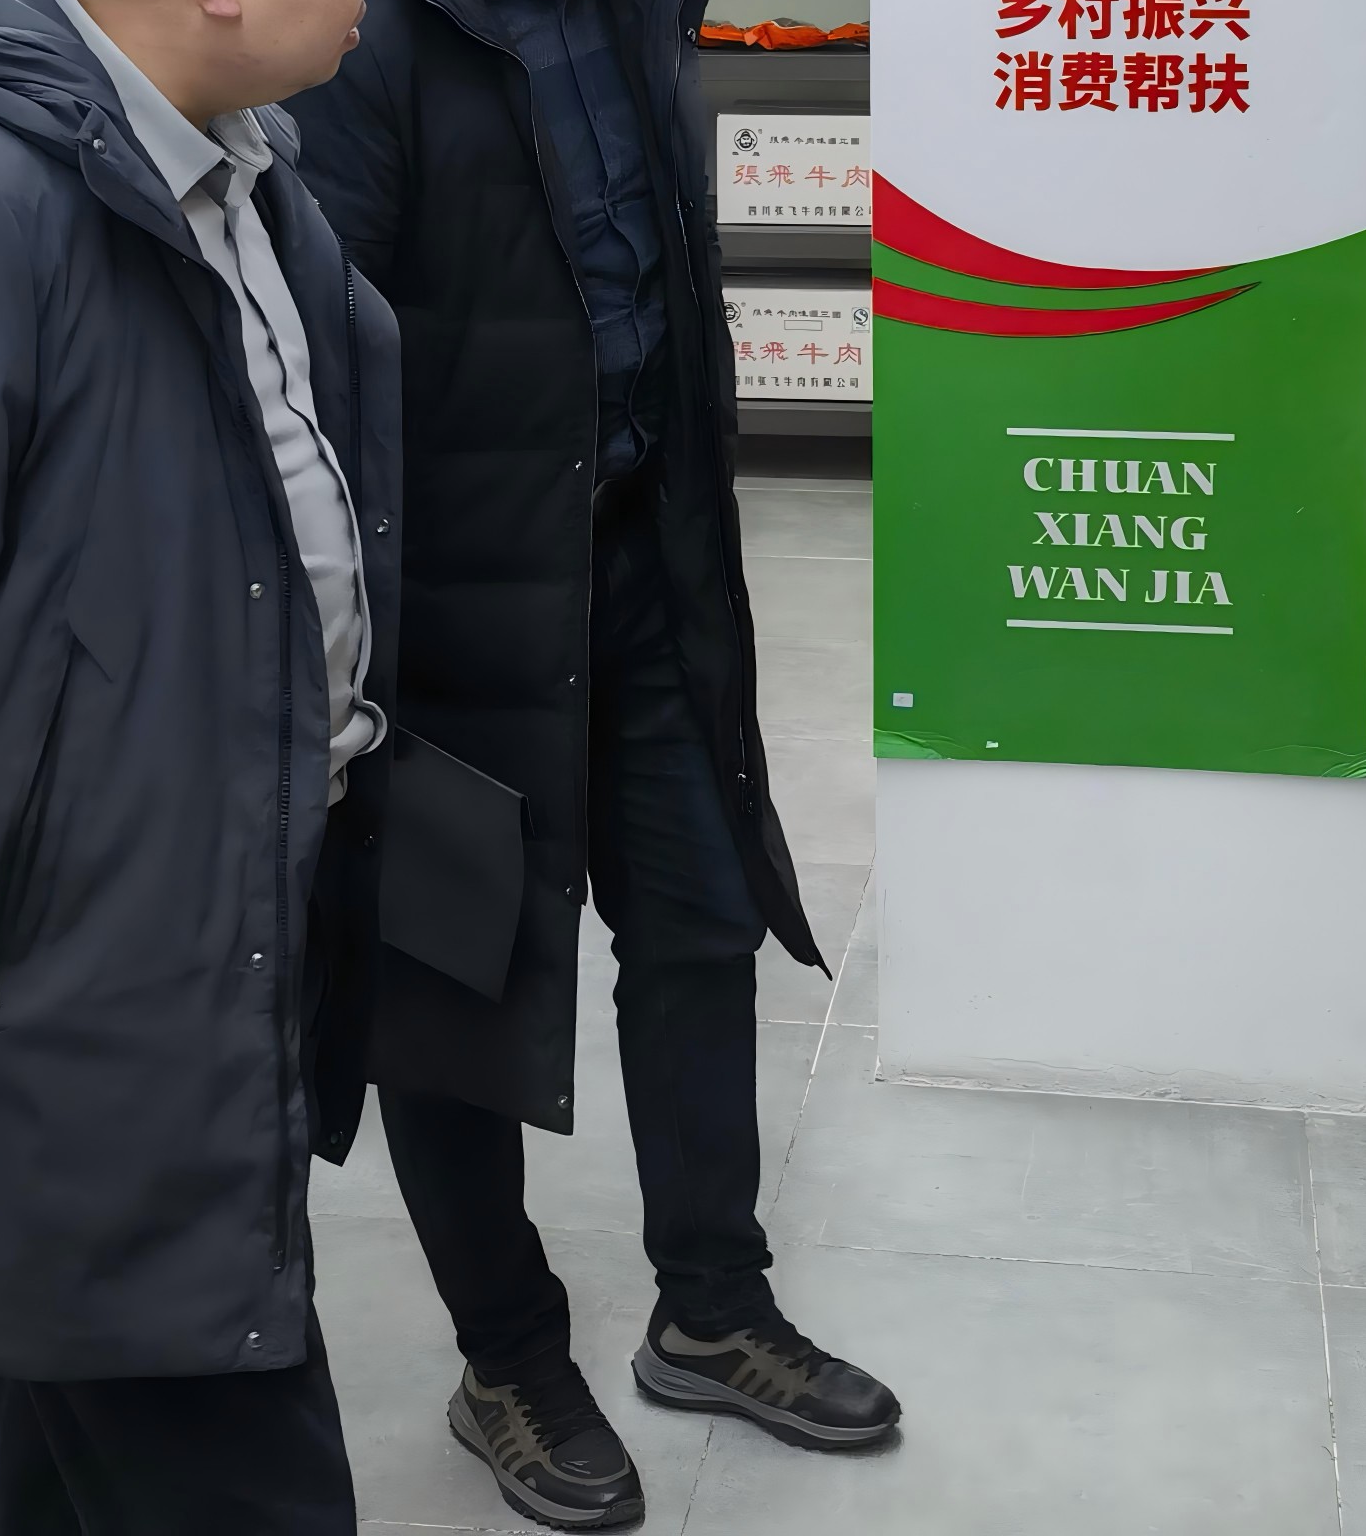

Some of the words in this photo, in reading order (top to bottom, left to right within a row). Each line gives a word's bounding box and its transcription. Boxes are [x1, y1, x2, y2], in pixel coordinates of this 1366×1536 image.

[993, 50, 1251, 114] 消费帮扶
[748, 205, 872, 217] 四川张飞牛肉有限公
[1023, 457, 1217, 496] CHUAN
[1032, 511, 1208, 551] XIANG
[1006, 565, 1131, 602] WAN
[1144, 569, 1234, 606] JIA
